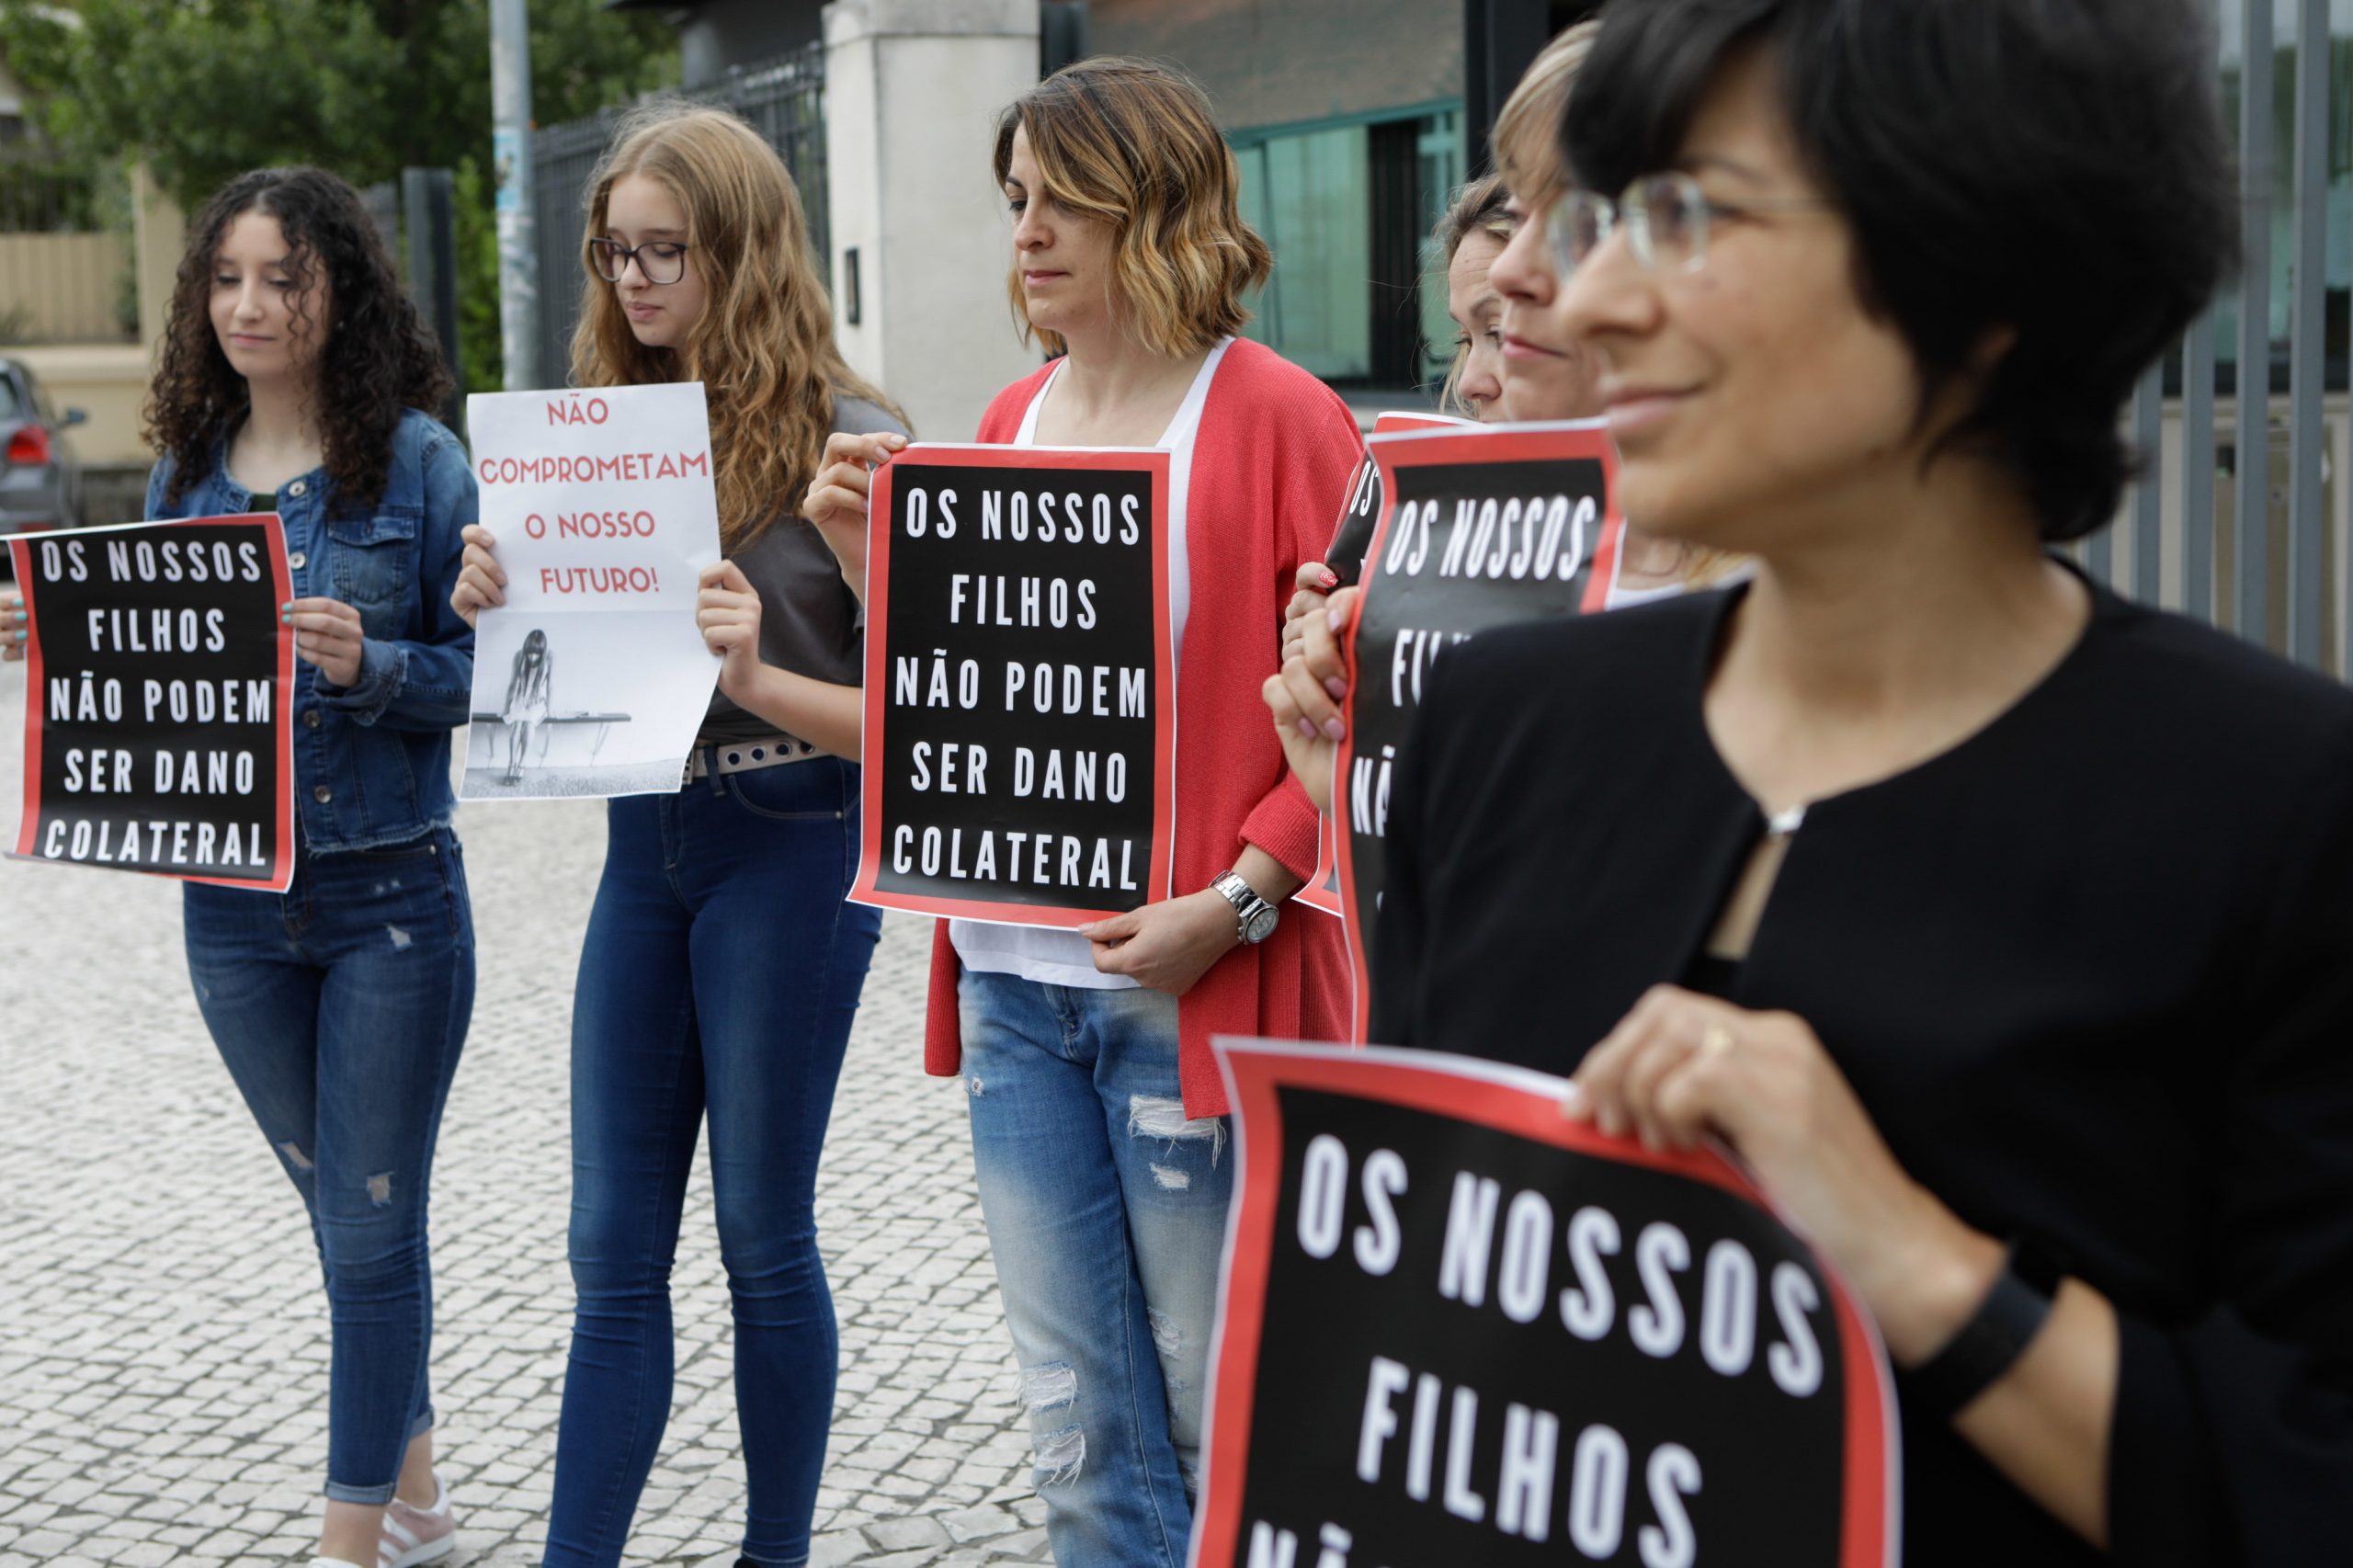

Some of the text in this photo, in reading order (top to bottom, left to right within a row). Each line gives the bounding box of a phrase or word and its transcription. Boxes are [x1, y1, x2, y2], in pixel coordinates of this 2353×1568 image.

[546, 393, 610, 426] NÃO
[479, 451, 708, 485] COMPROMETAM
[1348, 460, 1379, 517] OS
[525, 510, 656, 540] O NOSSO
[906, 487, 1140, 546] OS NOSSOS
[1385, 495, 1595, 580] OS NOSSOS
[41, 540, 260, 582] OS NOSSOS
[540, 565, 659, 594] FUTURO!
[950, 574, 1097, 630] FILHOS
[88, 608, 225, 653] FILHOS
[51, 670, 270, 723] NÃO PODEM
[895, 648, 1145, 719] NÃO PODEM
[63, 748, 254, 795] SER DANO
[910, 741, 1126, 803] SER DANO
[44, 818, 267, 867] COLATERAL
[892, 824, 1137, 891] COLATERAL
[1298, 1135, 1824, 1398] OS NOSSOS
[1356, 1355, 1703, 1568] FILHOS
